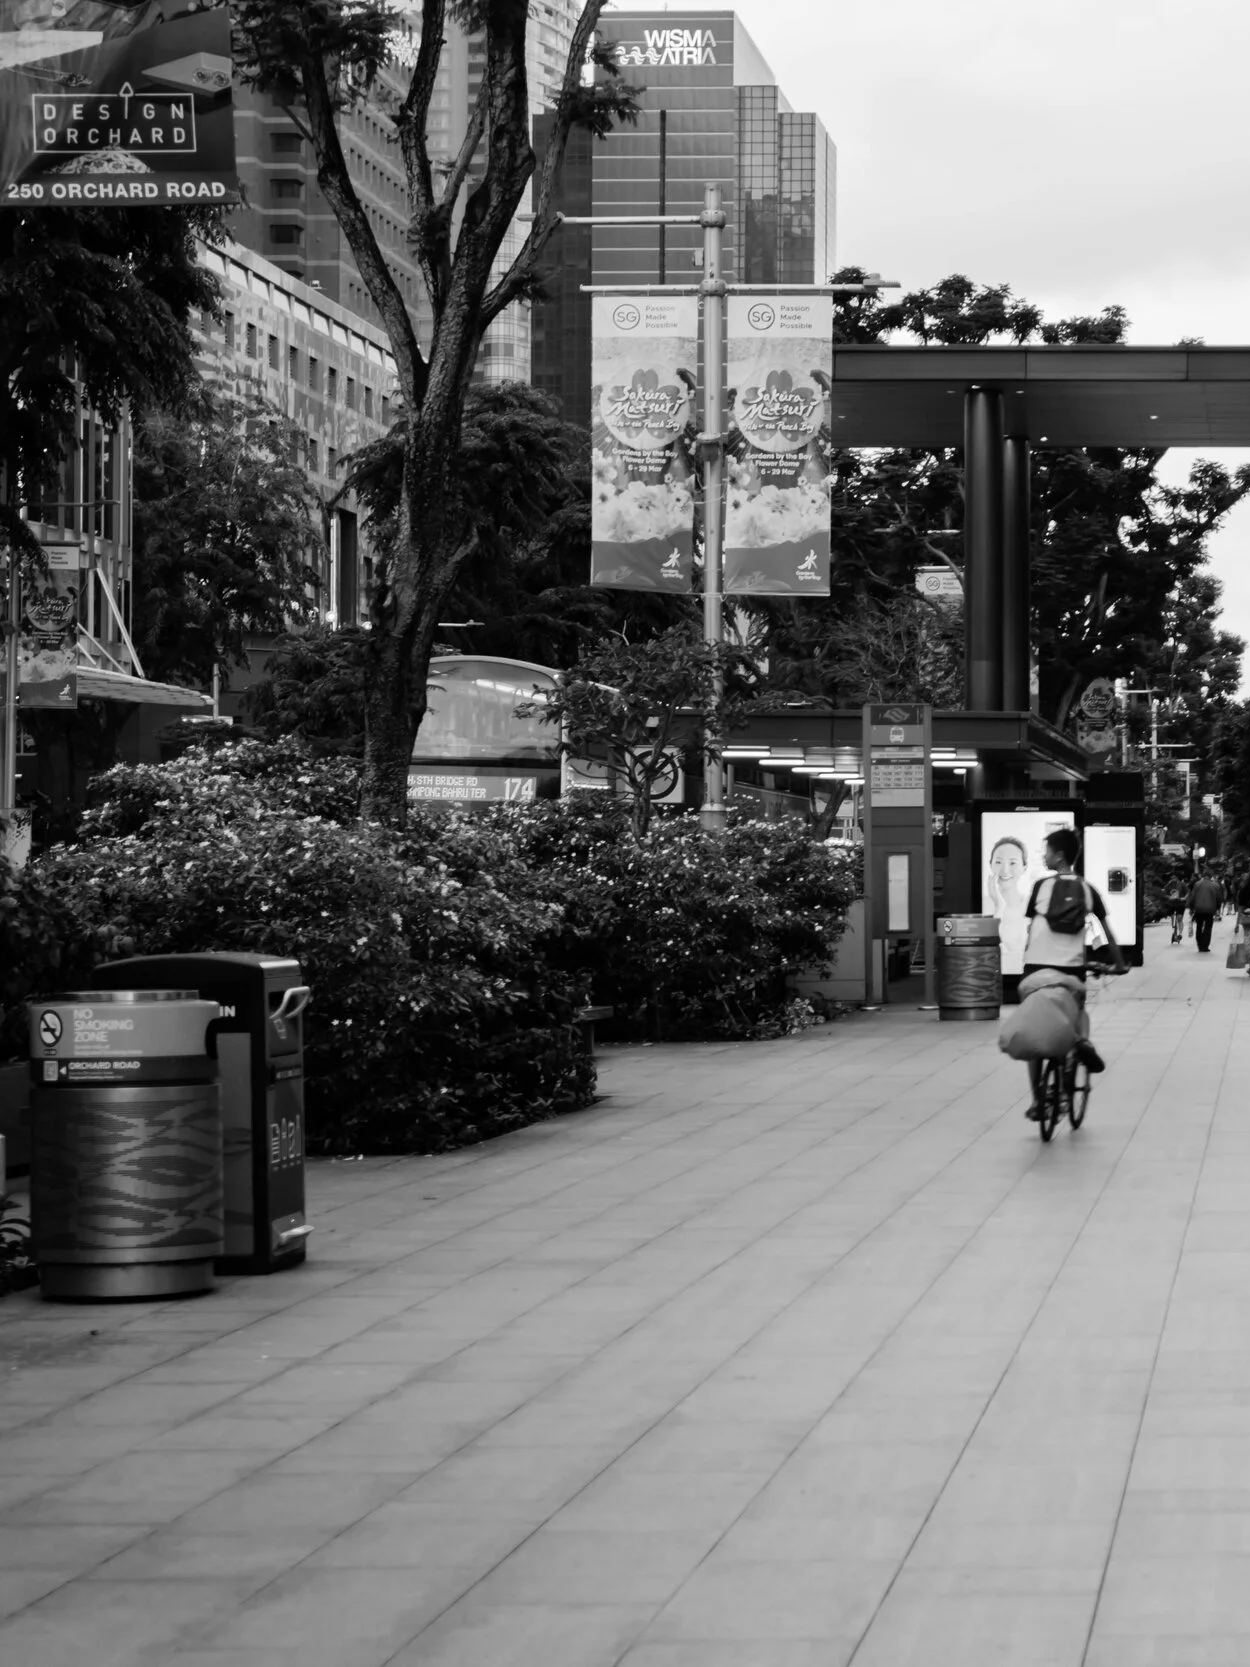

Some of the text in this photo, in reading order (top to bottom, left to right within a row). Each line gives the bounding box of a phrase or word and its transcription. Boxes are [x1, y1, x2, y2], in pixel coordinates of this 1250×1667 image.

[643, 29, 717, 48] WISMA
[660, 47, 717, 65] ATRIA
[43, 103, 185, 120] DESIGN
[43, 127, 187, 144] ORCHARD
[7, 181, 227, 199] 250 ORCHARD ROAD
[614, 384, 672, 403] Sakura
[748, 385, 806, 404] Sakura
[606, 400, 685, 419] Matsuri
[739, 400, 820, 420] Matsuri
[435, 776, 464, 786] BRIDGE
[466, 776, 478, 787] RD
[504, 778, 534, 800] 174
[442, 787, 468, 798] BAHRU
[470, 787, 487, 799] TER
[73, 1008, 93, 1019] NO
[74, 1019, 134, 1031] SMOKING
[74, 1031, 109, 1042] ZONE
